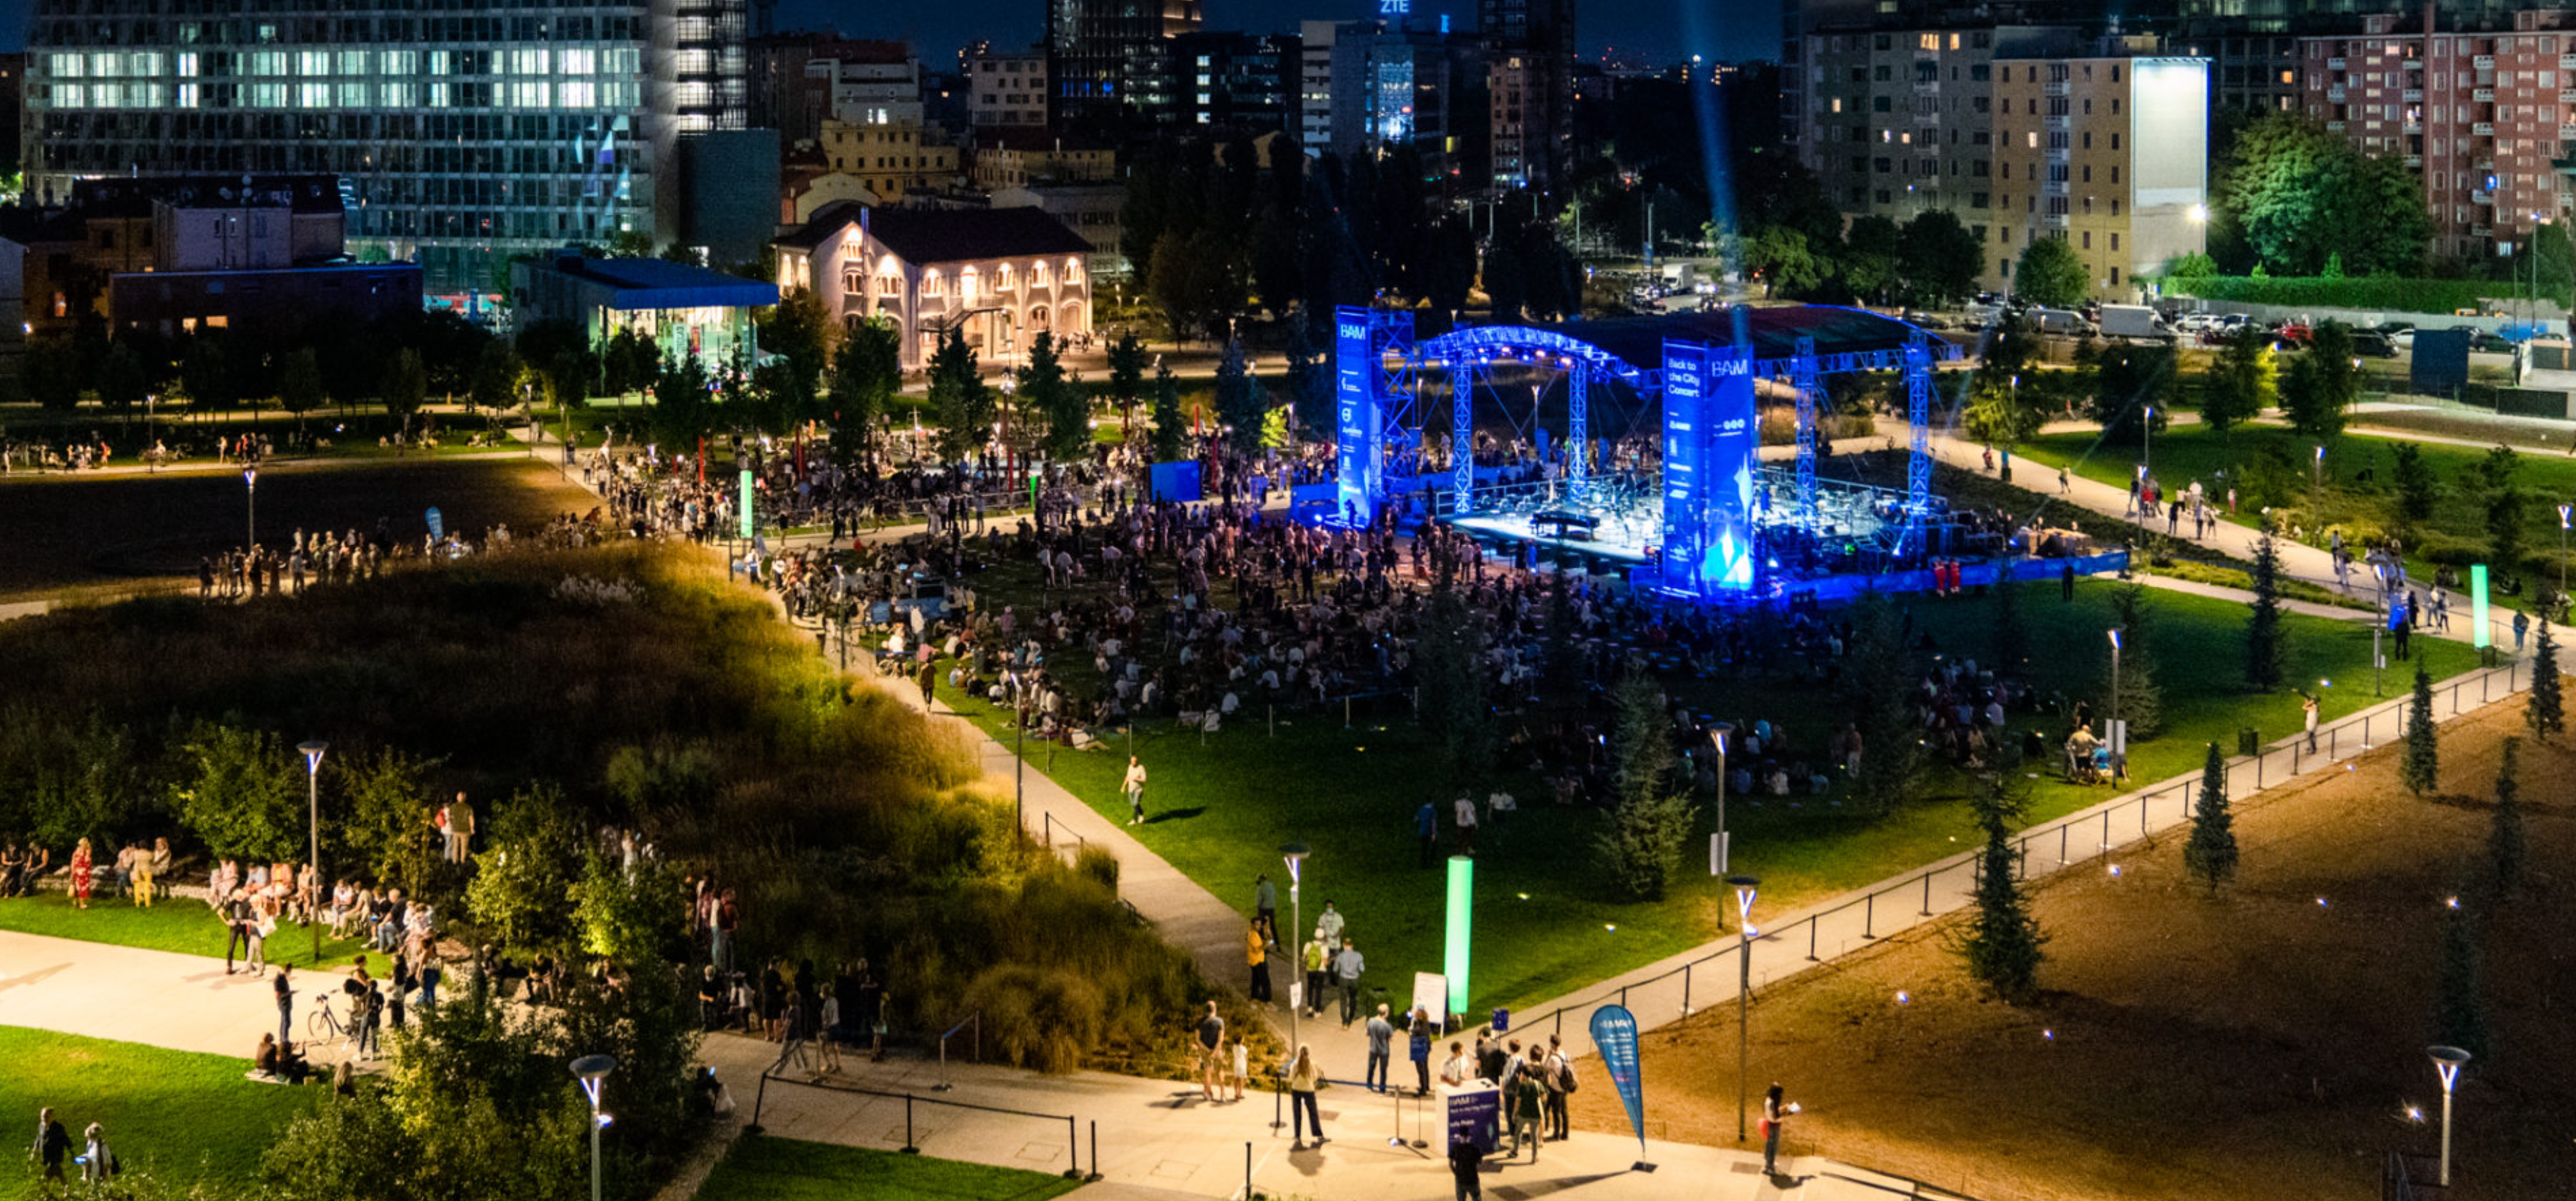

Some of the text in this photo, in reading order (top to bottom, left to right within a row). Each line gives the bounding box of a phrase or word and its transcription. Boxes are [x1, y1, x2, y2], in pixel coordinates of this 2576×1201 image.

[1380, 0, 1409, 13] ZTE
[1340, 324, 1365, 340] BAM
[1711, 359, 1748, 377] BAM
[1683, 373, 1700, 387] City
[1668, 384, 1700, 398] Concert
